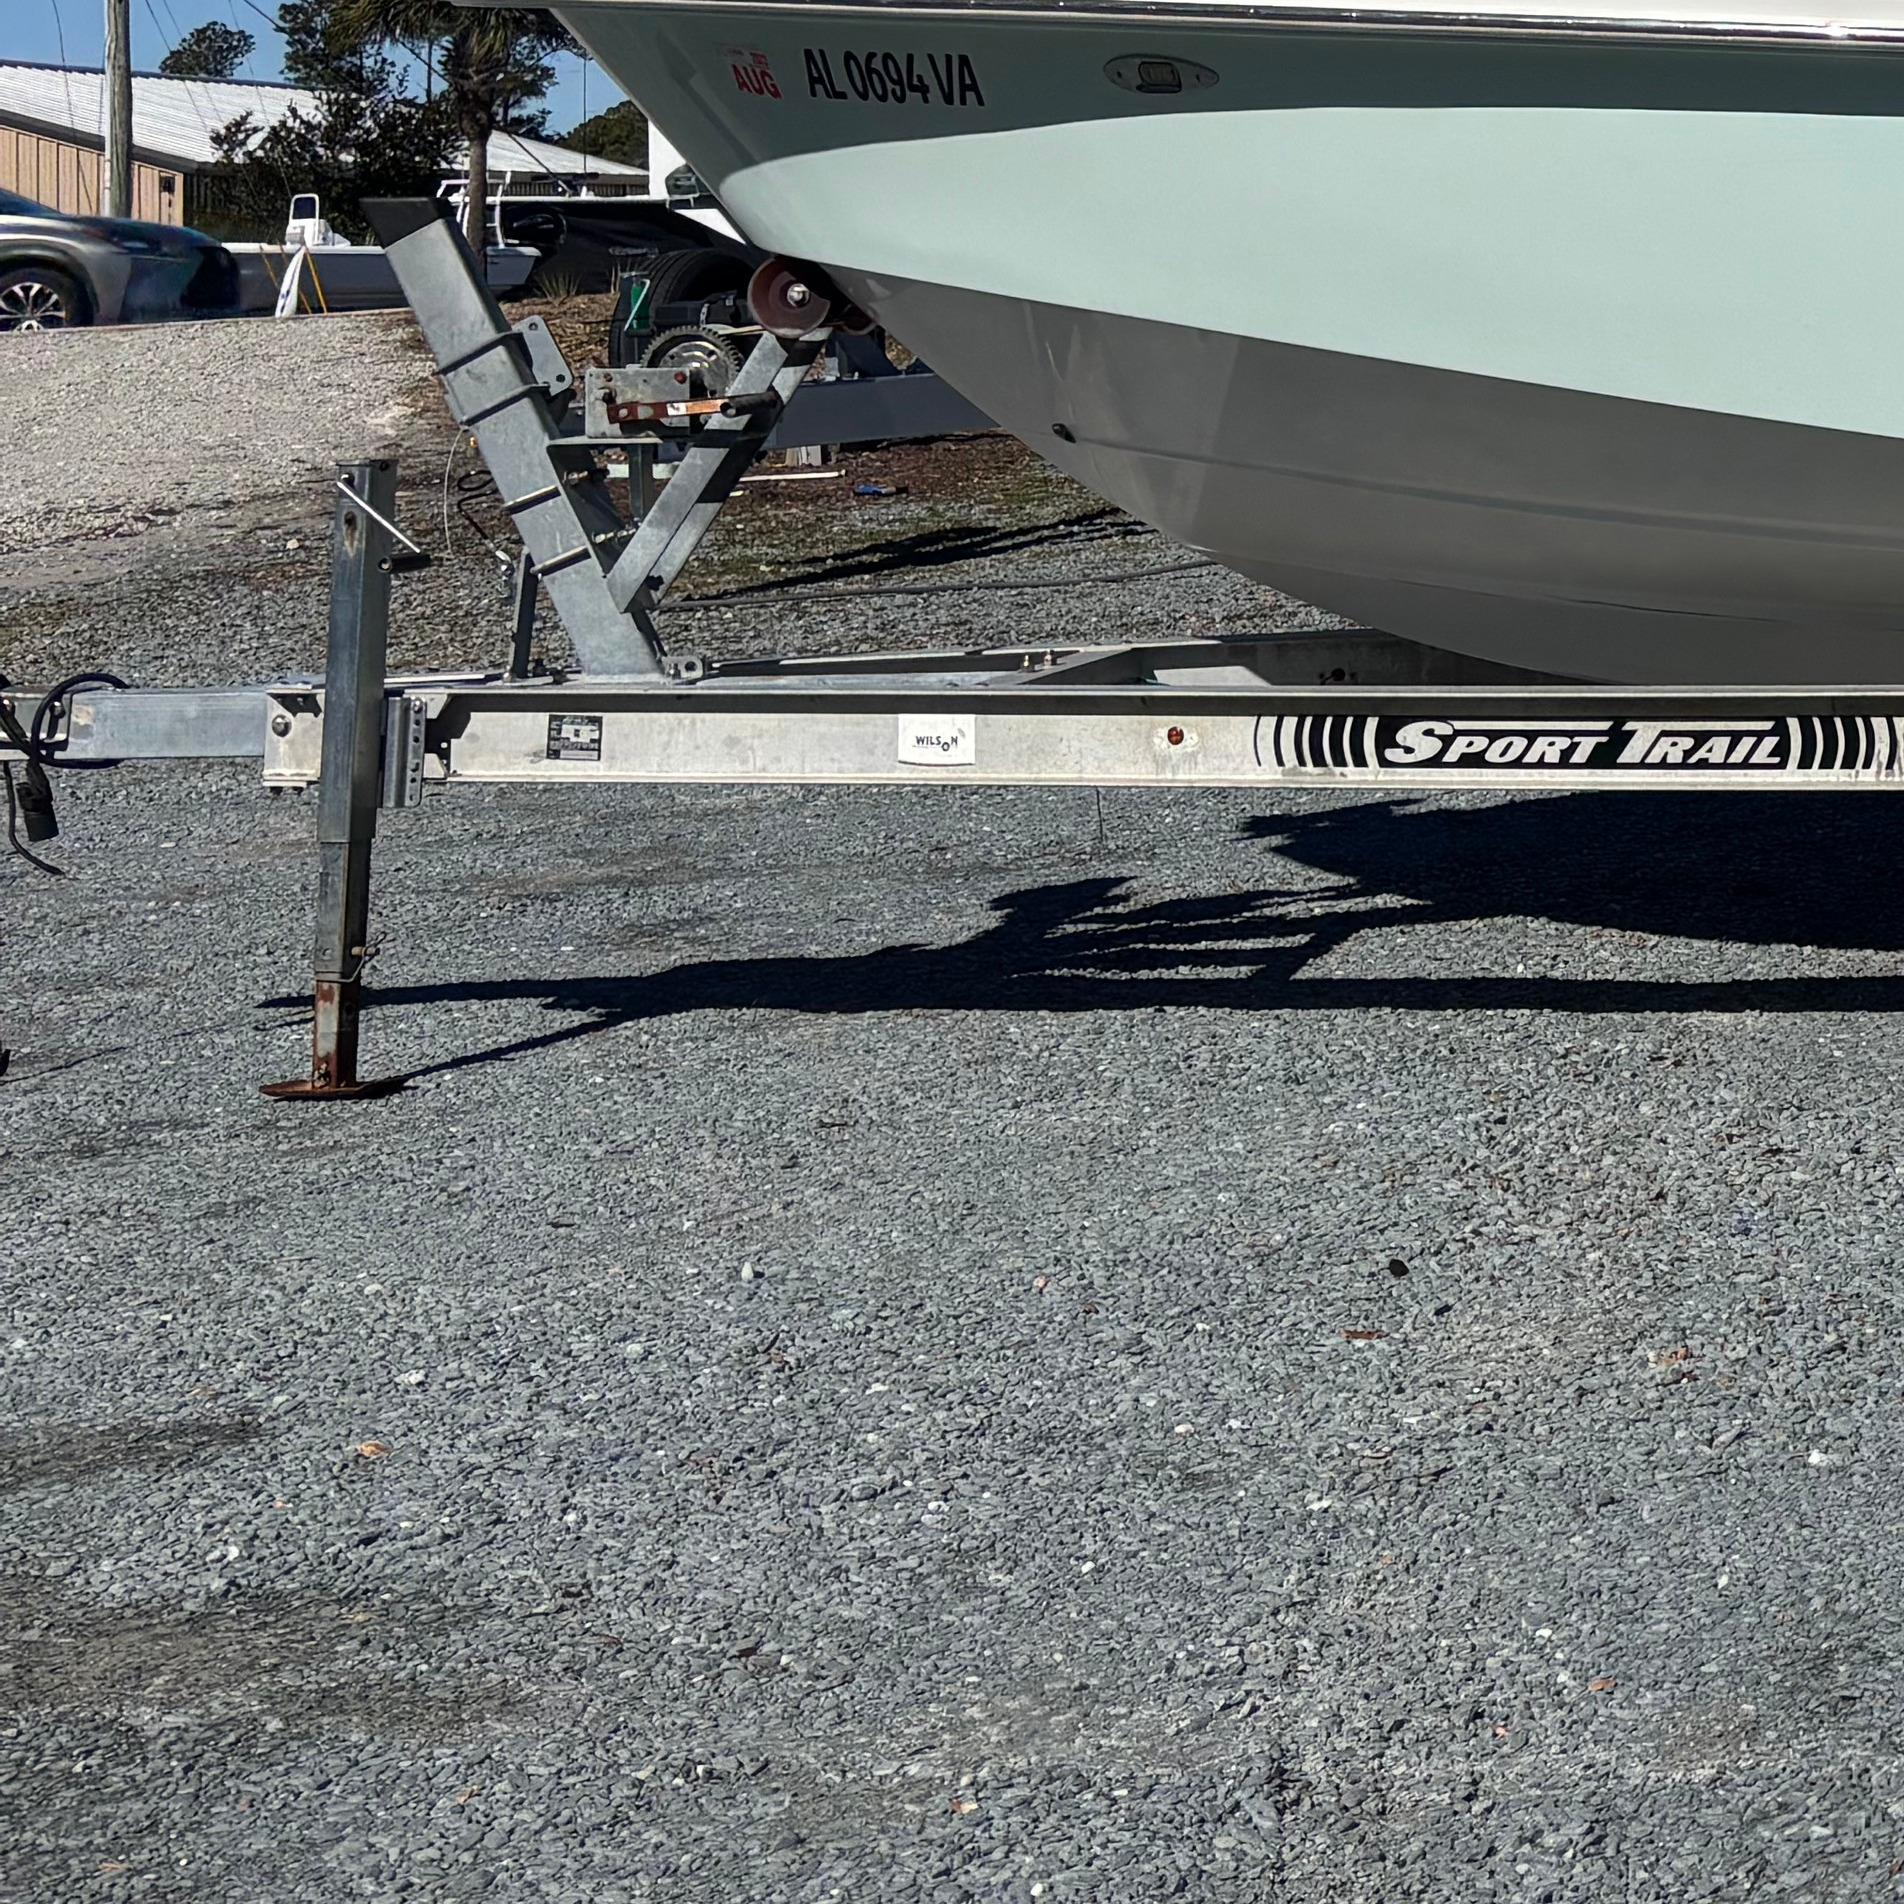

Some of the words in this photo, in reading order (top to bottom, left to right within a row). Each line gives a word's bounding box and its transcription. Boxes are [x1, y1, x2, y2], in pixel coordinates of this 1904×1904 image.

[731, 63, 784, 101] AUG
[804, 48, 848, 100] AL
[843, 50, 930, 105] 0694
[927, 53, 985, 107] VA
[915, 735, 958, 752] WILSON
[1383, 720, 1614, 764] SPORT
[1616, 720, 1781, 764] TRAIL
